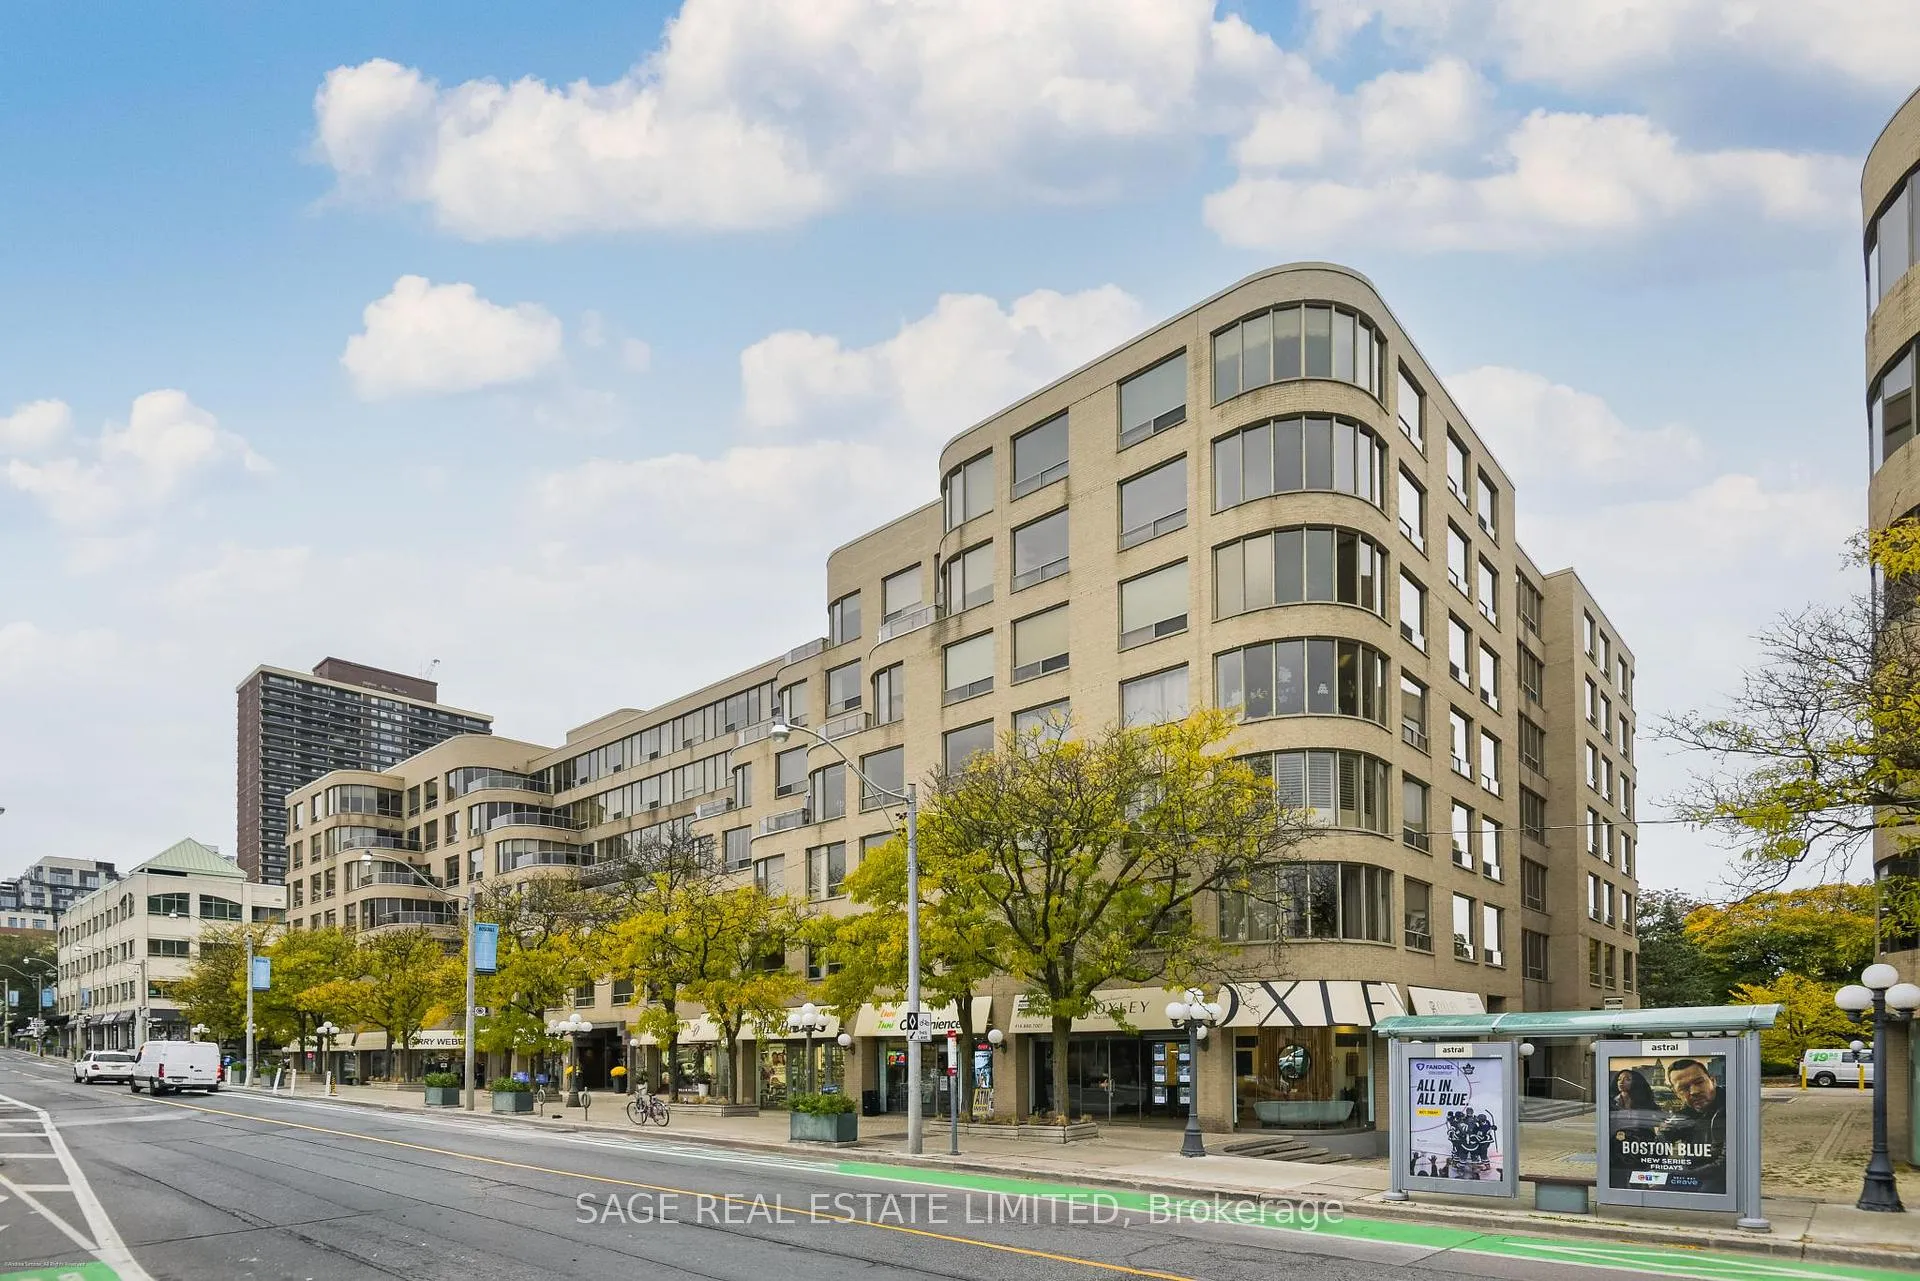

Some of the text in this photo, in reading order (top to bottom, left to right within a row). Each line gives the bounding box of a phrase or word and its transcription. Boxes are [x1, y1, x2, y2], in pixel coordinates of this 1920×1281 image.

[899, 1016, 961, 1031] Cnience
[437, 1038, 466, 1046] WEBE
[1651, 1043, 1679, 1051] astral
[1417, 1079, 1453, 1092] ALL IN.
[1417, 1093, 1469, 1106] ALL BLUE.
[1622, 1141, 1712, 1157] BOSTON BLUE
